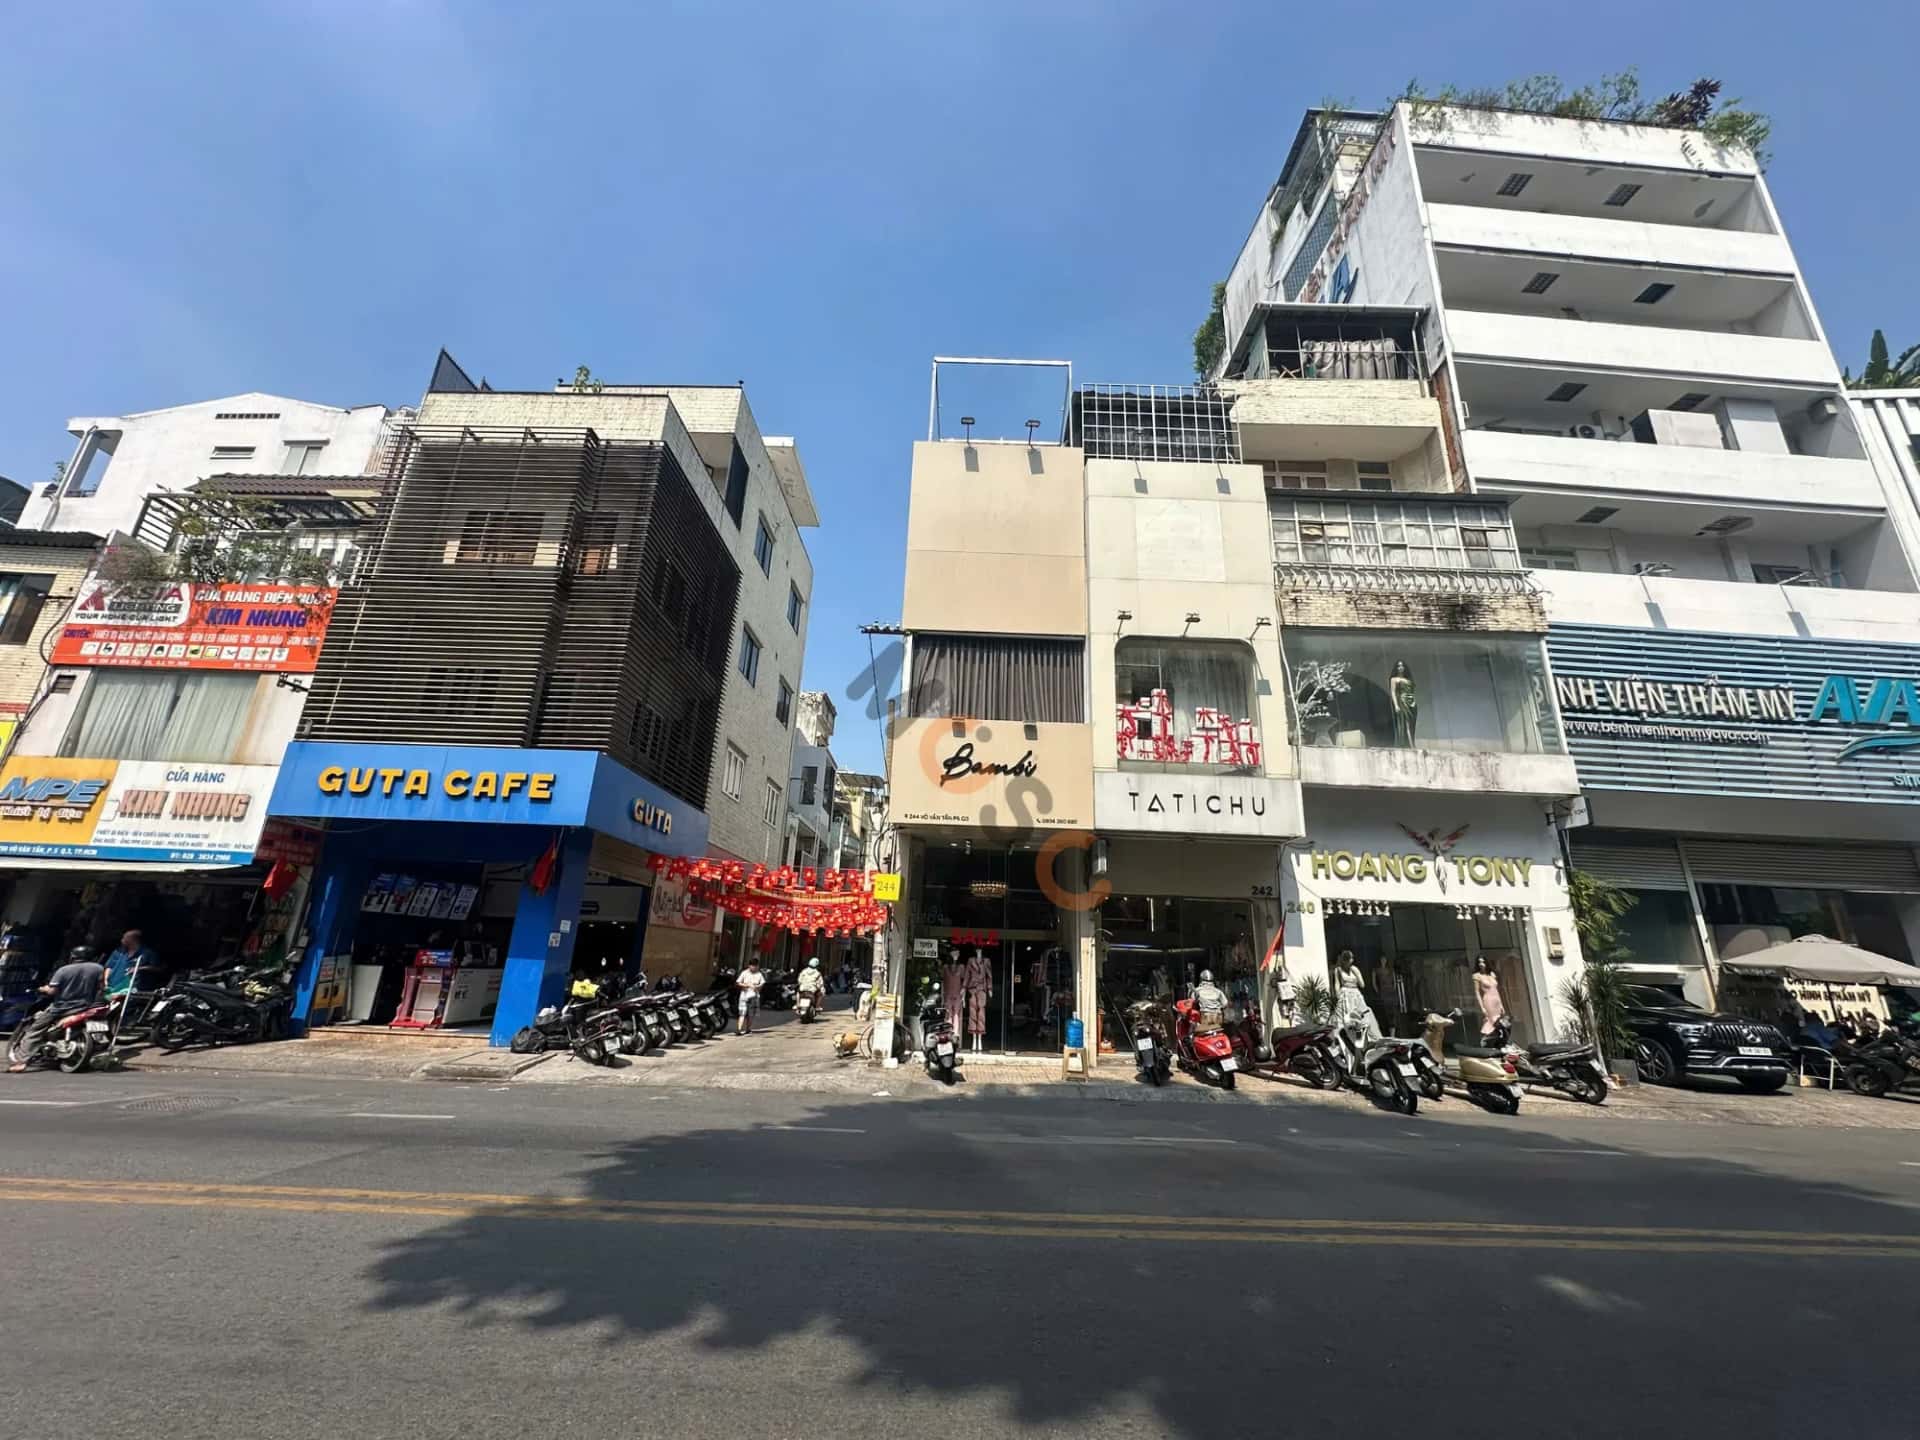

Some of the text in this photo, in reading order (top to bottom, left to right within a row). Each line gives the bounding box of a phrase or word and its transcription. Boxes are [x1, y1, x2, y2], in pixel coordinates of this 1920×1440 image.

[205, 606, 307, 628] KIM NHUNG
[1605, 674, 1668, 720] VIỆN
[1671, 673, 1752, 720] THẨM
[1755, 682, 1797, 720] MỸ
[166, 767, 226, 784] CỬA HÀNG
[317, 765, 556, 800] GUTA CAFE
[0, 777, 109, 804] MPE
[120, 789, 252, 820] KIM NHUNG
[1128, 791, 1266, 816] TATICHU
[633, 798, 672, 835] GUTA
[1310, 850, 1534, 887] HOANG TONY
[877, 880, 896, 892] 244
[1251, 885, 1273, 896] 242
[1287, 901, 1316, 915] 240
[952, 928, 999, 946] SALE
